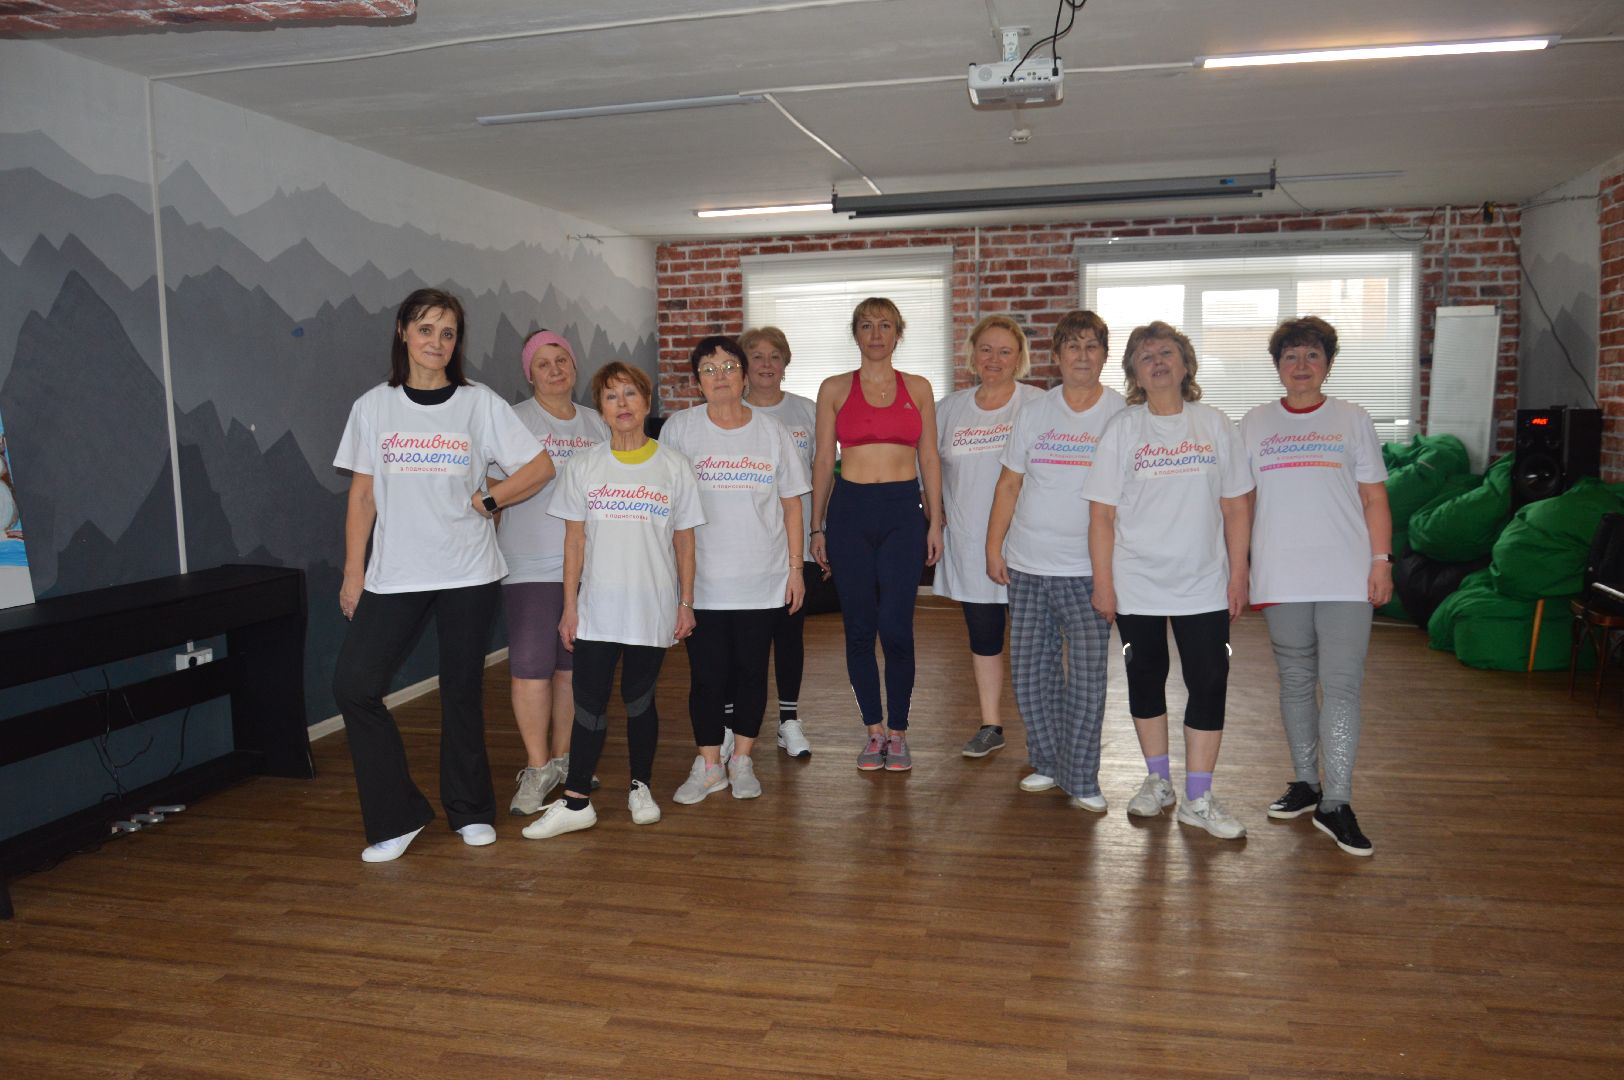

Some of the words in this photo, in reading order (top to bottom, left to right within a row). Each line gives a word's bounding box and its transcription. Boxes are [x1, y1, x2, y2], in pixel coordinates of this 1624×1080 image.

[382, 432, 469, 451] Активное
[1260, 431, 1344, 447] Активное
[382, 447, 470, 466] долголетие
[1134, 441, 1214, 460] Активное
[1260, 443, 1345, 457] долголетие
[694, 456, 773, 472] Активное
[1134, 455, 1217, 471] долголетие
[696, 466, 774, 484] долголетие
[588, 483, 669, 505] Активное
[587, 496, 671, 518] долголетие
